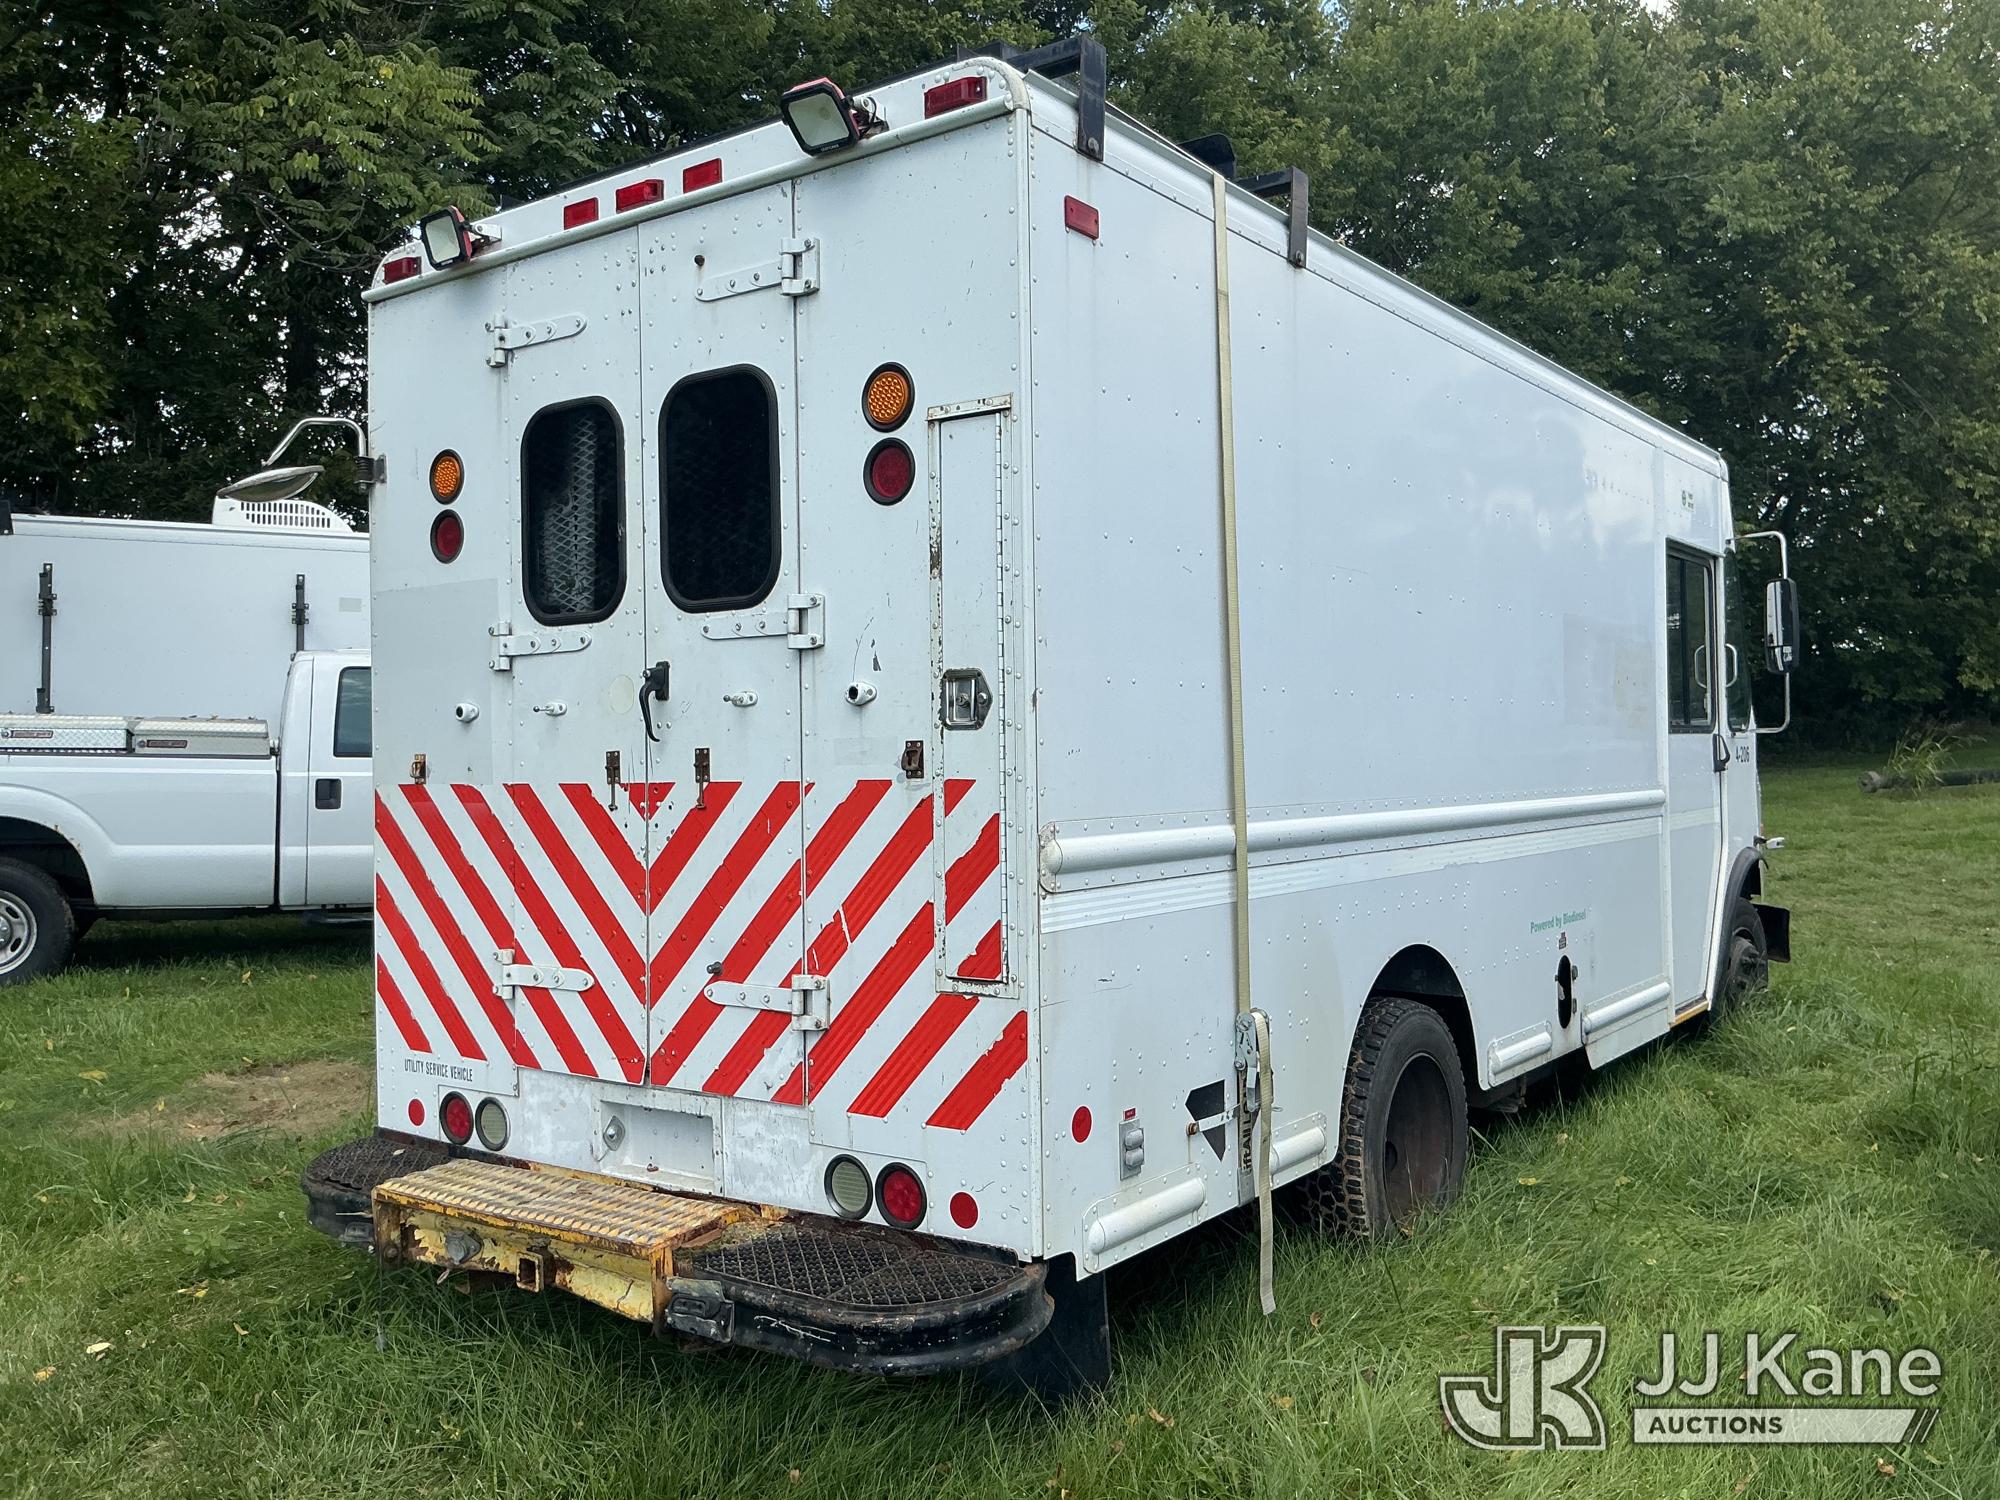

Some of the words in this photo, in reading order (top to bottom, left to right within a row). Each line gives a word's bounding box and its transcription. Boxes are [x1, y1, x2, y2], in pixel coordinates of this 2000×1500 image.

[1735, 745, 1750, 763] 4-206
[1530, 915, 1555, 934] Powered
[1555, 914, 1562, 929] by
[404, 1058, 424, 1074] UTILITY
[426, 1061, 449, 1079] SERVICE
[450, 1064, 474, 1083] VEHICLE
[1242, 1128, 1253, 1172] iftAll
